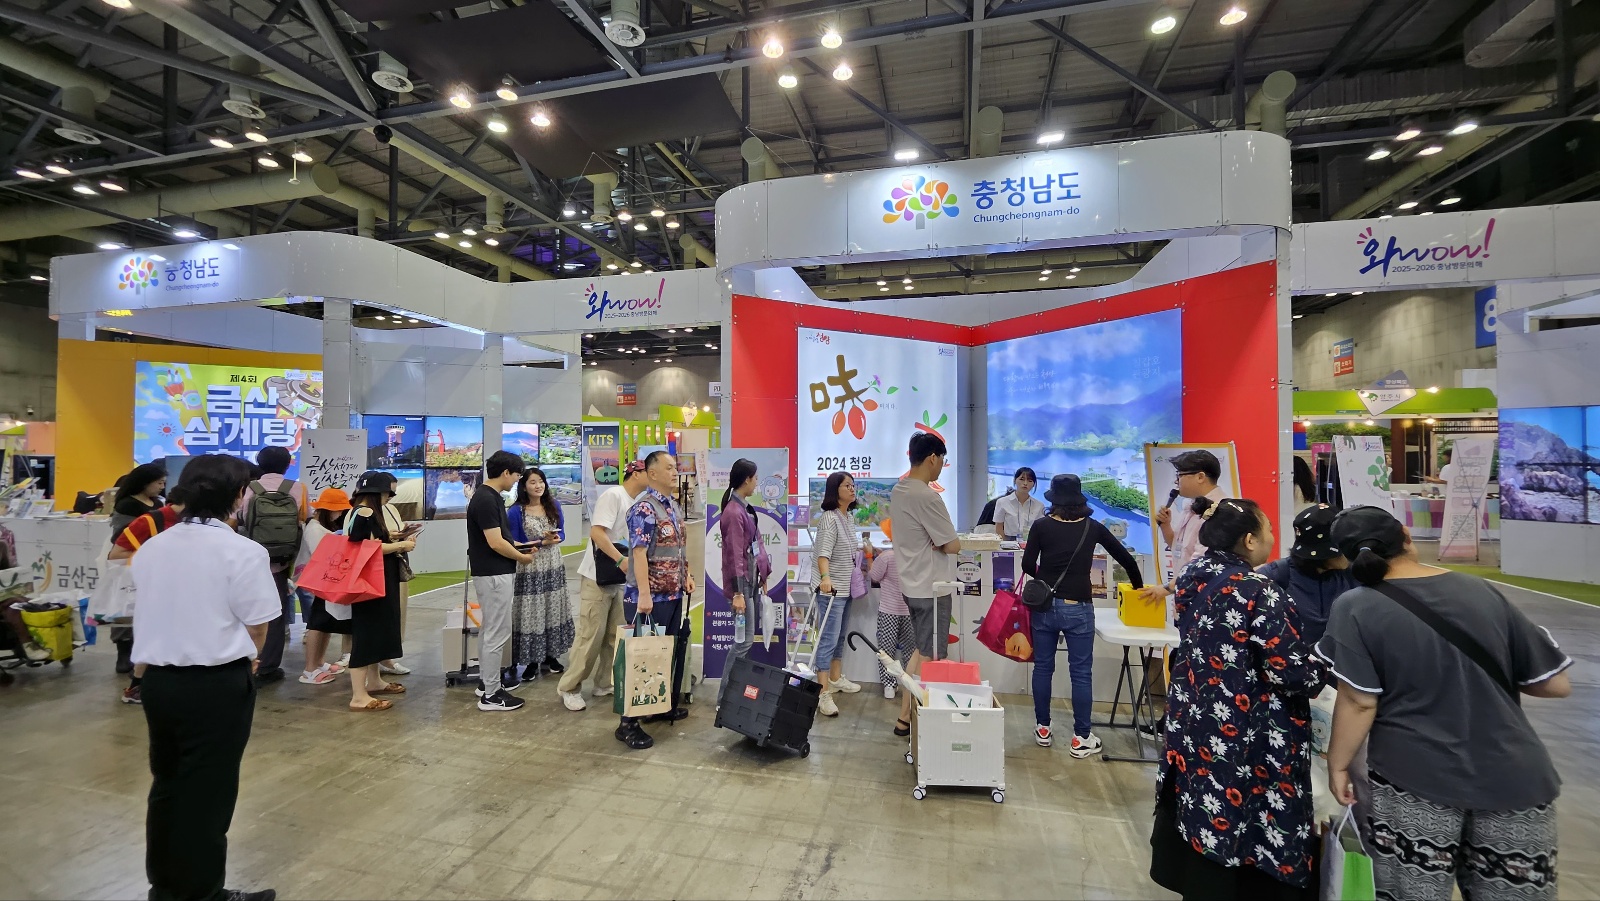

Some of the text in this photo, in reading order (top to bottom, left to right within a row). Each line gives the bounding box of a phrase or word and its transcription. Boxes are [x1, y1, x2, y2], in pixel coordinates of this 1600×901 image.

[971, 172, 1082, 210] 충청남도
[973, 206, 1080, 223] Chungcheongnam-do
[164, 257, 220, 281] 충청남도
[230, 374, 257, 383] 제4회
[206, 384, 279, 415] 금산
[183, 416, 298, 447] 삼계탕
[588, 434, 614, 446] KITS
[817, 455, 872, 471] 2024 청양
[57, 565, 99, 590] 금산군
